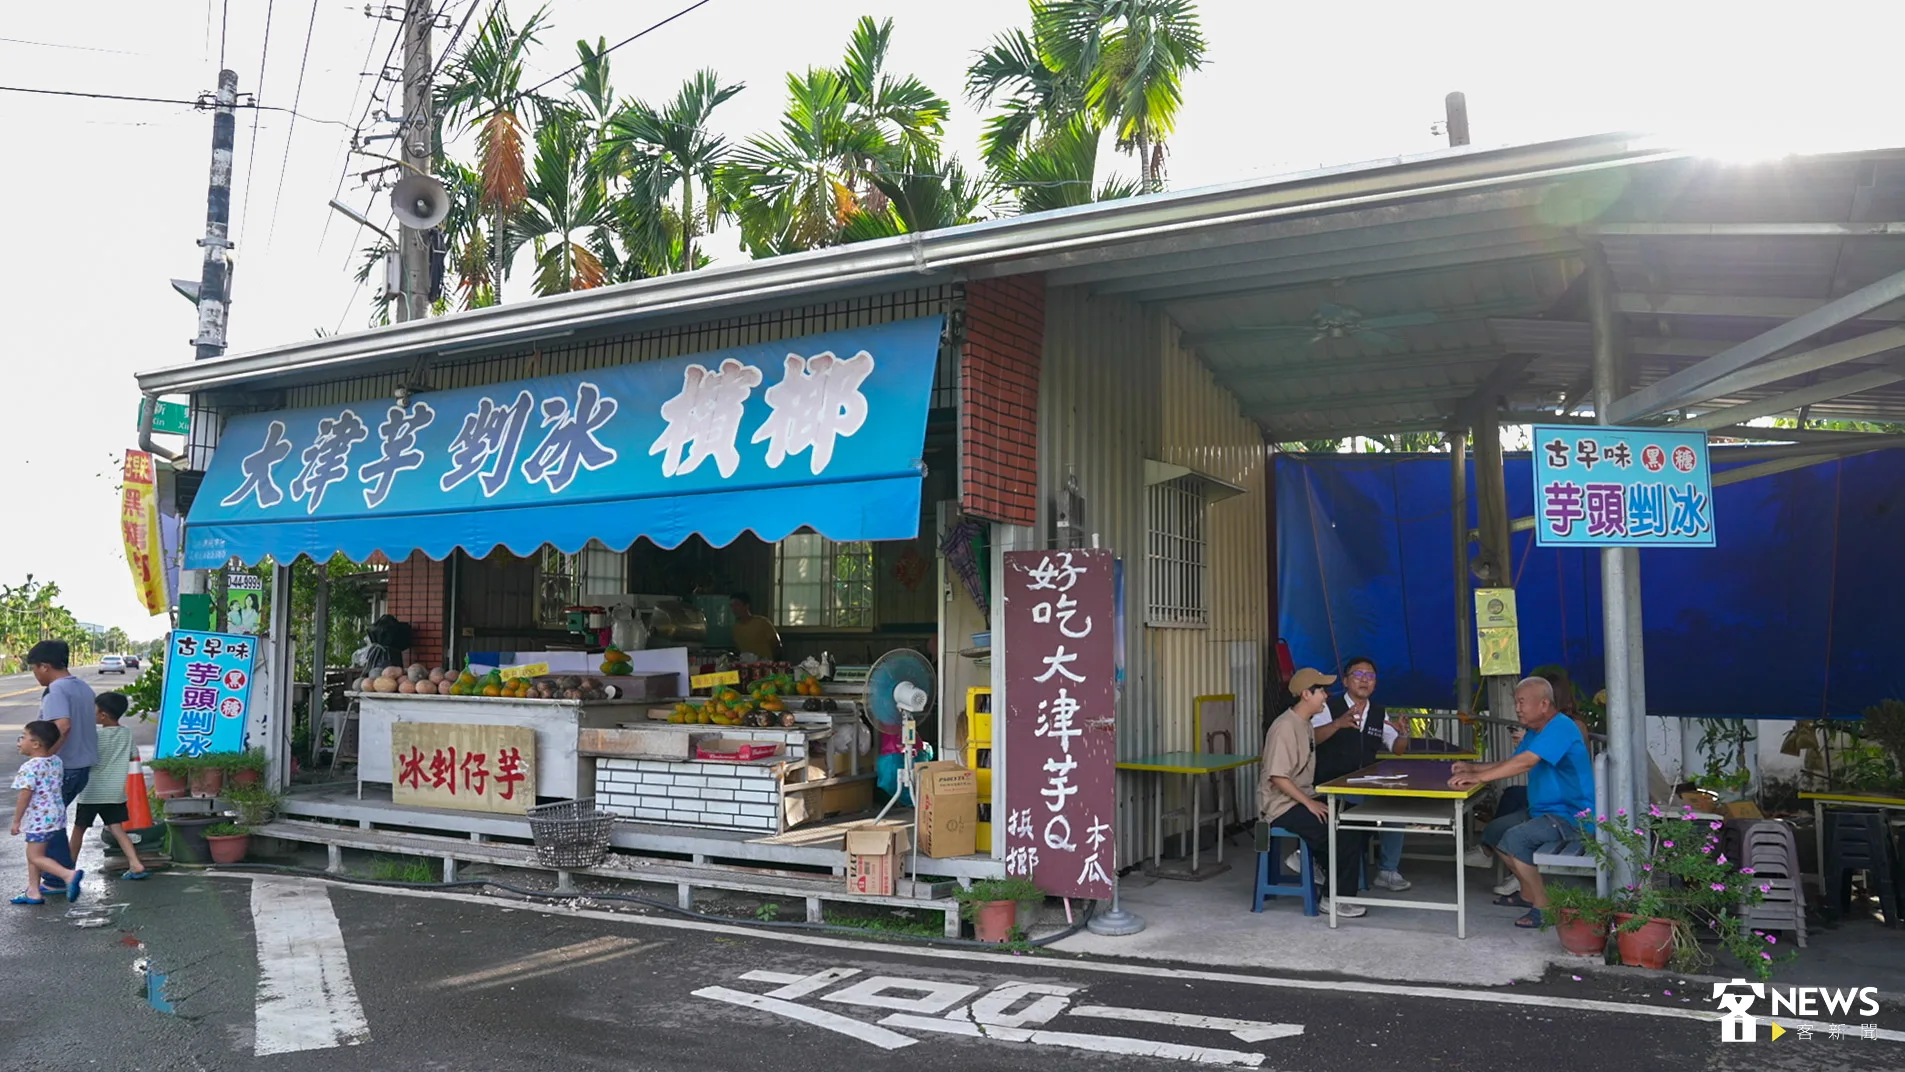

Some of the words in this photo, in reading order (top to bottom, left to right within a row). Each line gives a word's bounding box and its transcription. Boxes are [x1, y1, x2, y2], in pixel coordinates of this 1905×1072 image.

[1544, 439, 1632, 470] 古早味
[1544, 481, 1710, 538] 芋頭剉冰
[178, 637, 249, 660] 古早味
[175, 662, 222, 758] 芋頭剉冰
[1077, 815, 1113, 885] 木瓜
